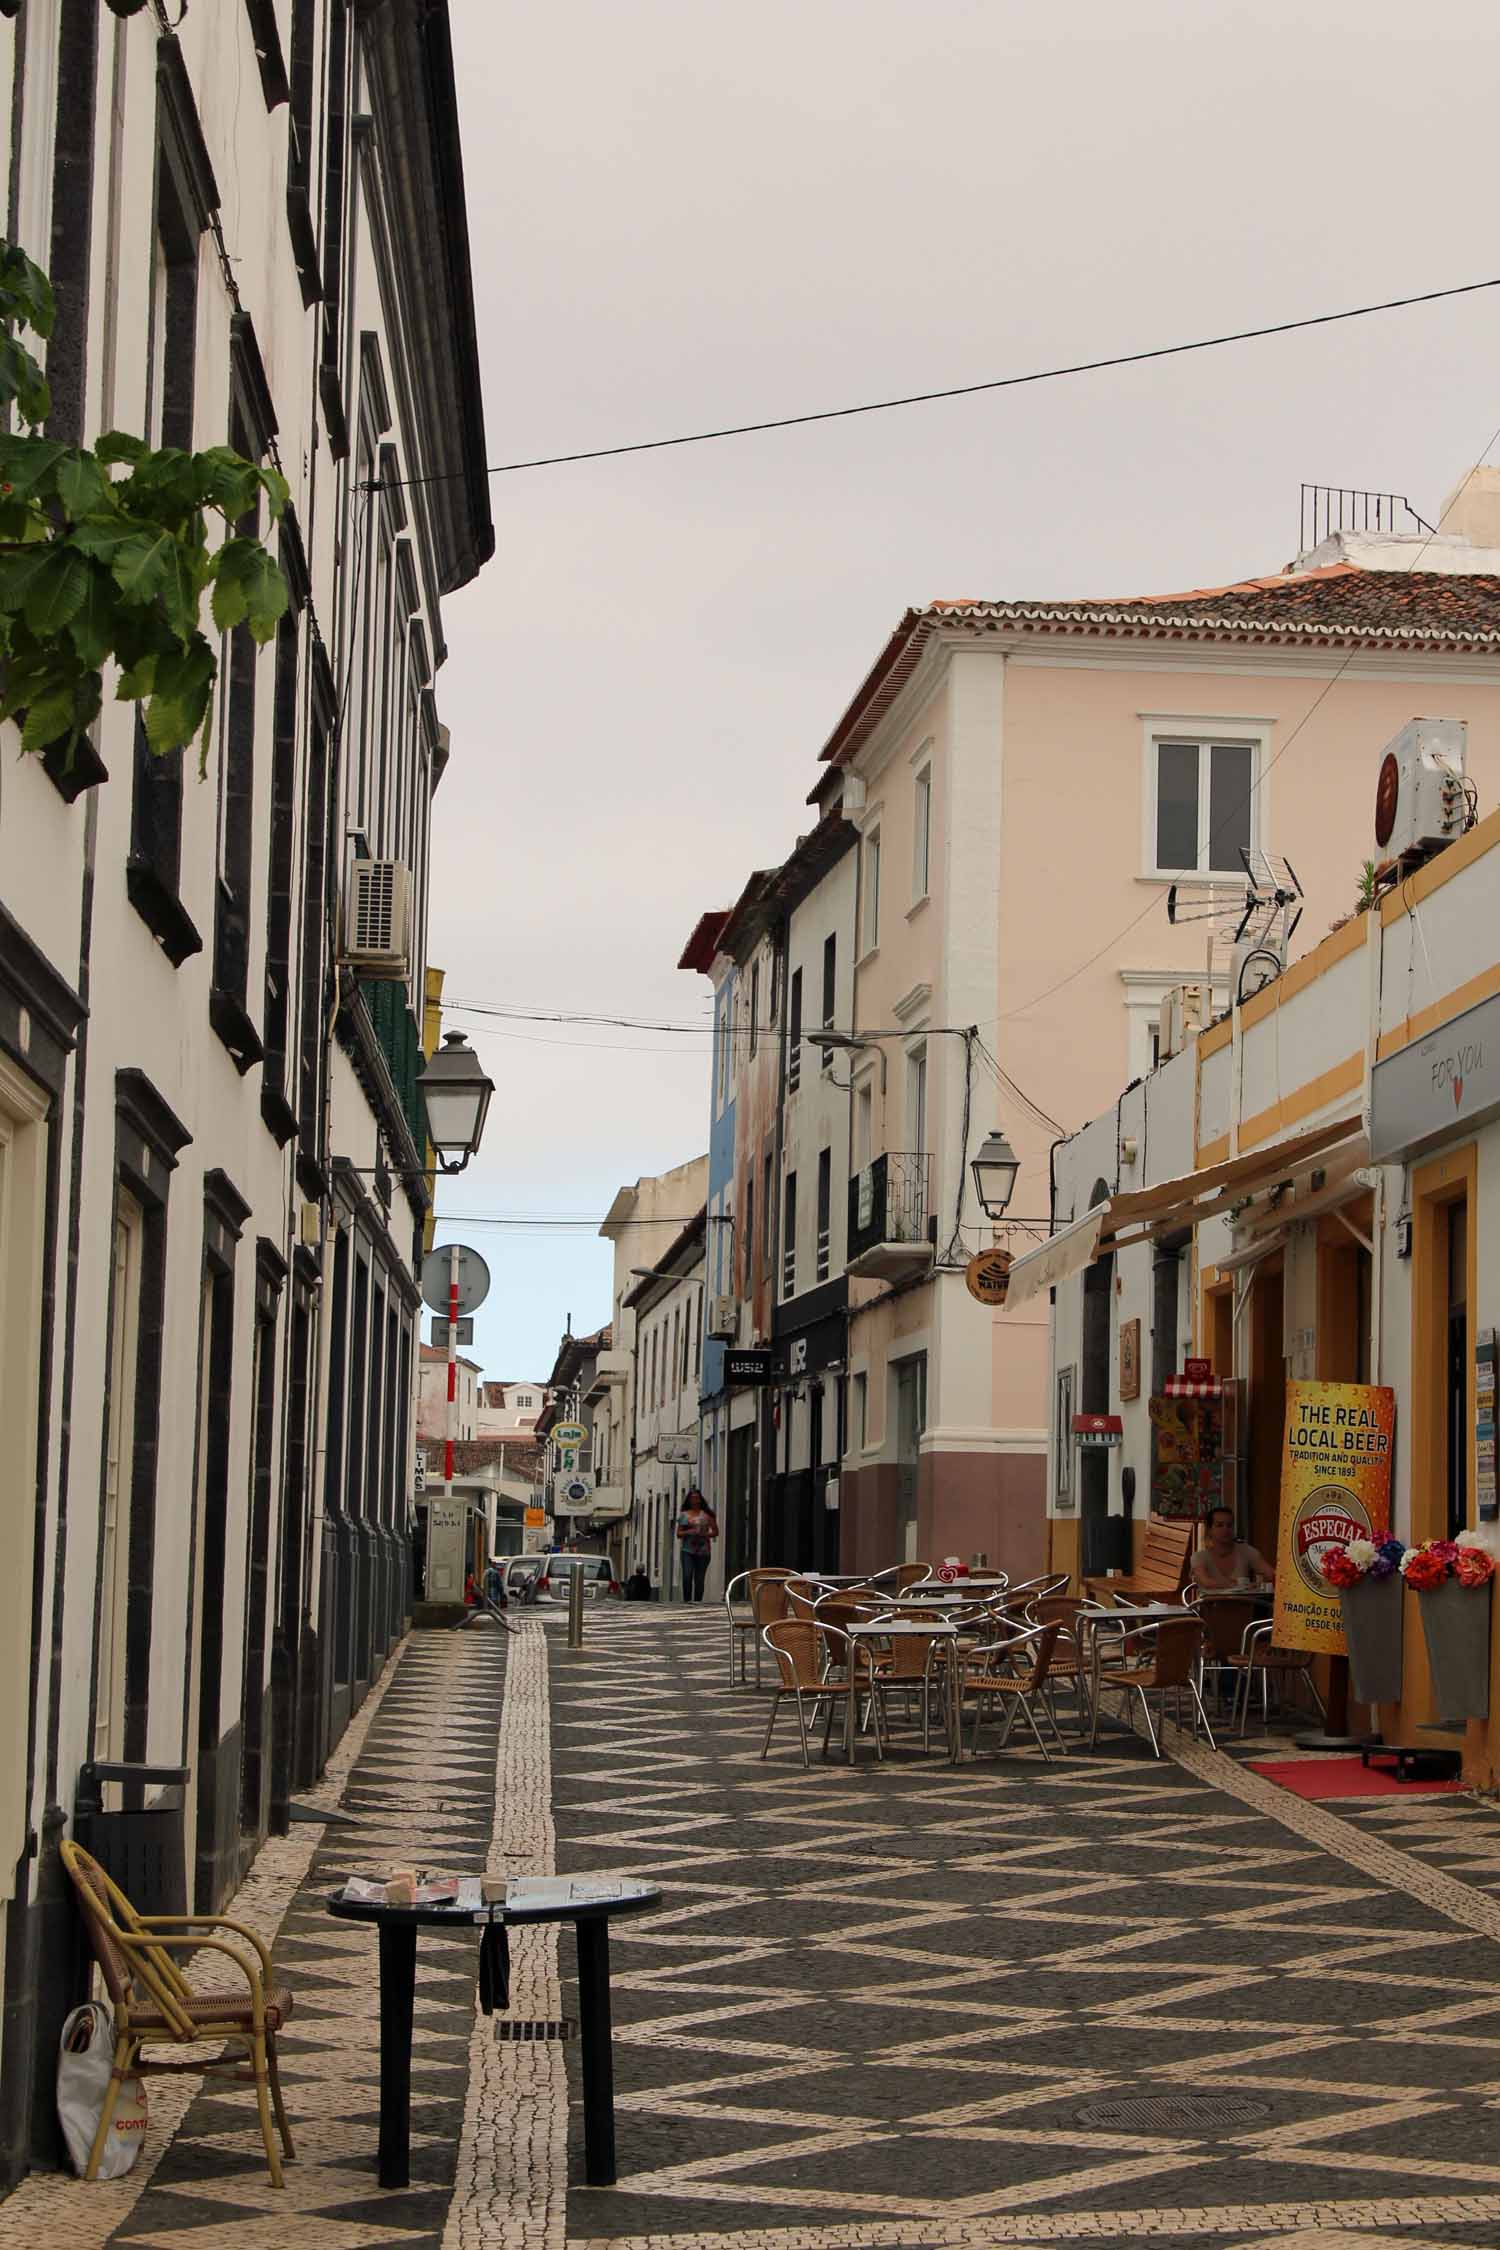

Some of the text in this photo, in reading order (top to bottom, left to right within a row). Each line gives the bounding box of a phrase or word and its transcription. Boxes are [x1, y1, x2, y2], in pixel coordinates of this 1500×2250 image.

[1432, 1058, 1456, 1094] FOR
[1300, 1405, 1378, 1428] THE REAL
[1289, 1426, 1387, 1452] LOCAL BEER
[1290, 1450, 1384, 1465] TRADITION AND QUALITY
[1314, 1465, 1356, 1476] SINCE 1893
[1303, 1520, 1362, 1541] ESPECIAL
[1283, 1602, 1322, 1615] TRADIÇÃO
[1323, 1608, 1329, 1616] E
[1305, 1618, 1330, 1630] DESDE
